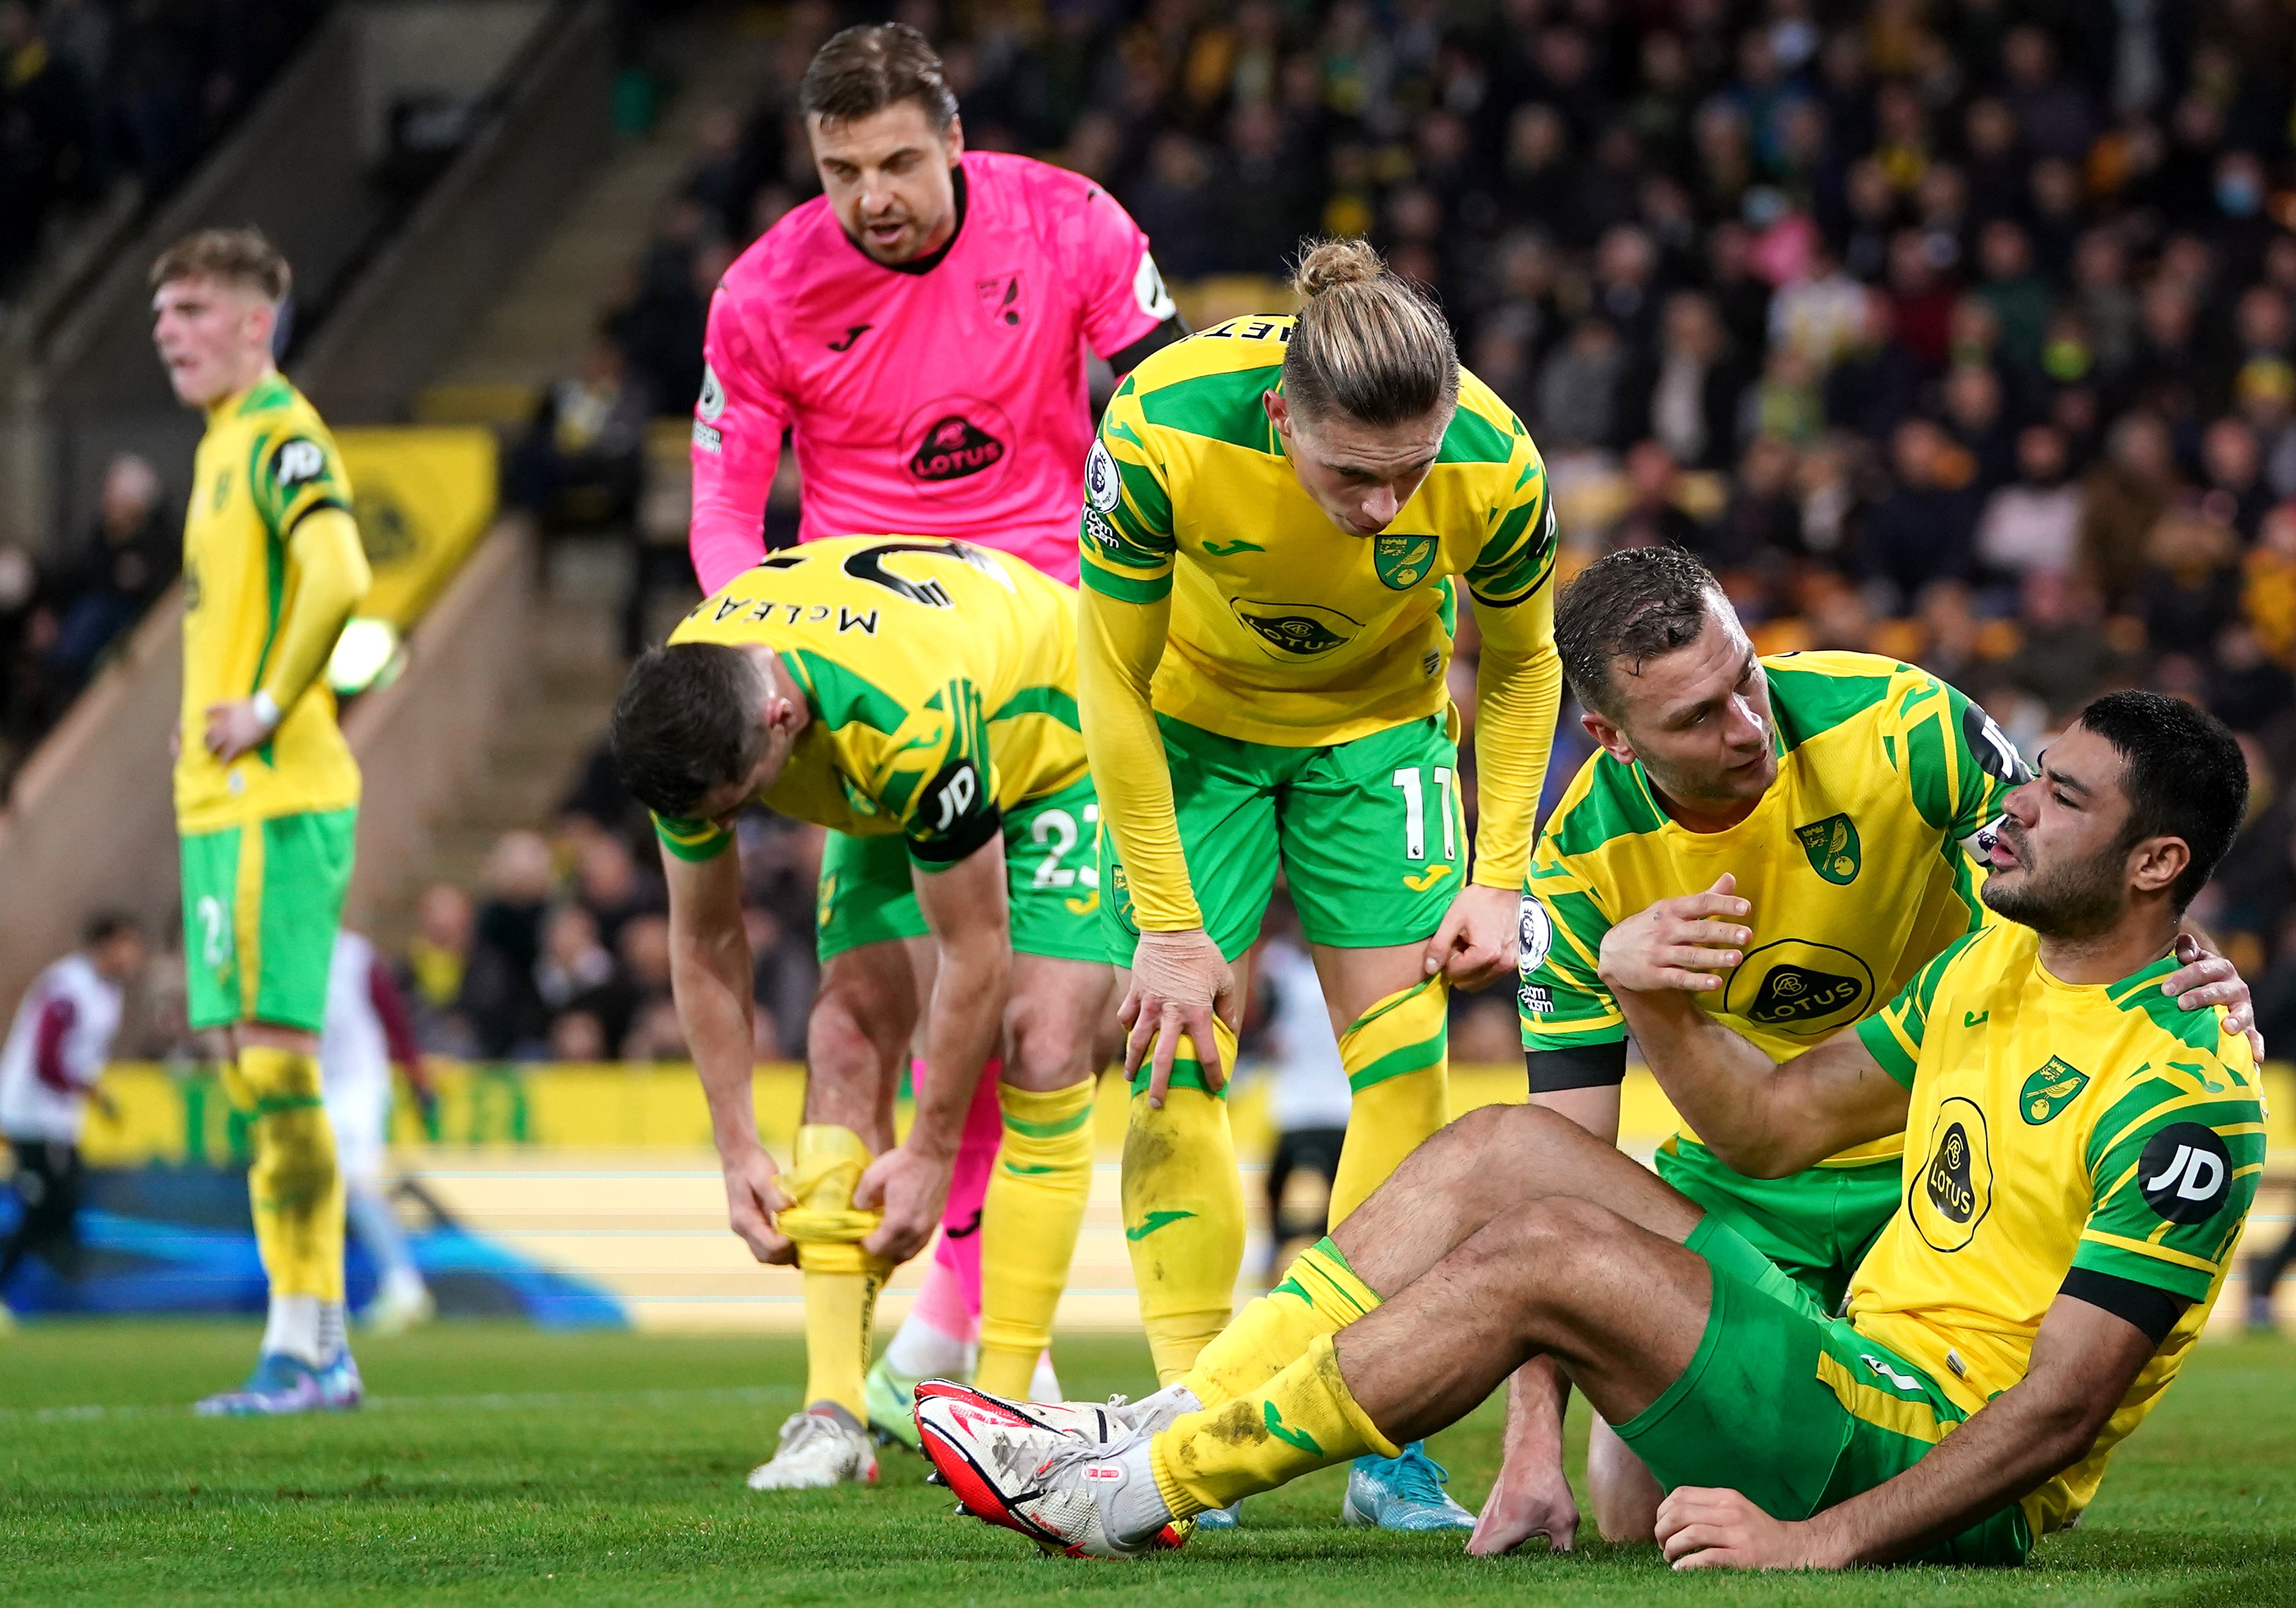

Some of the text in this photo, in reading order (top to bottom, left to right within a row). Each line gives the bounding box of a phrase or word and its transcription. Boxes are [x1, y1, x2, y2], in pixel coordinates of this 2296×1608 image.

[277, 439, 322, 487] JD
[915, 441, 1000, 477] LOTUS
[936, 766, 975, 832] JD
[1392, 766, 1456, 862] 11
[1756, 982, 1855, 1021] LOTUS
[1930, 1162, 1971, 1215] LOTUS
[2146, 1144, 2224, 1202] JD
